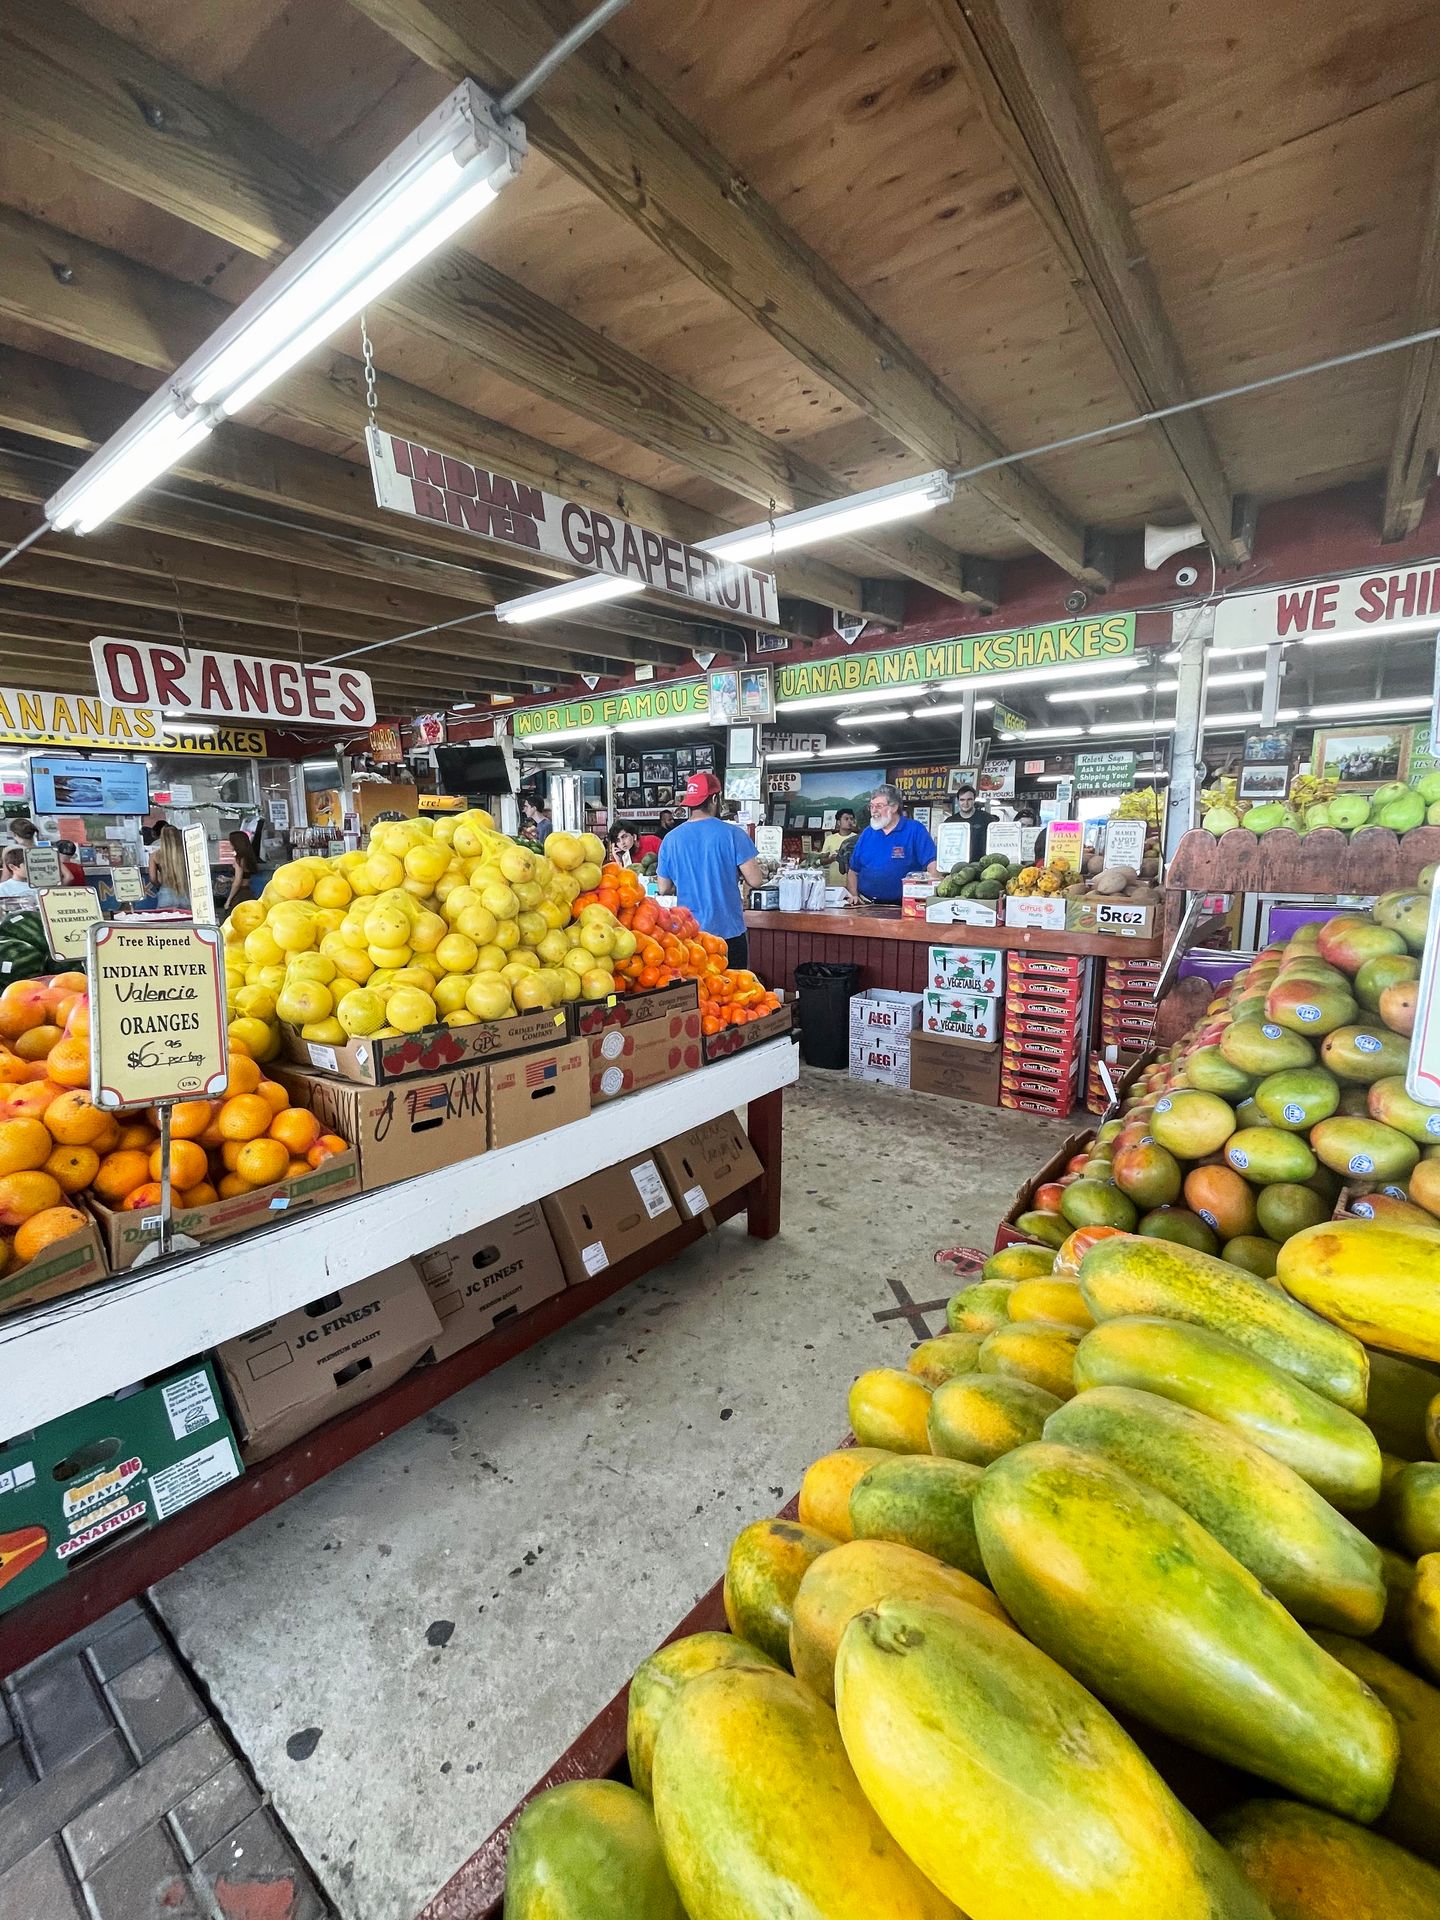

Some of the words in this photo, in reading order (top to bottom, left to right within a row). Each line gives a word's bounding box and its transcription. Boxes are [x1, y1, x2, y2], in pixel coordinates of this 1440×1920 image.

[390, 436, 546, 522] INDIAN
[410, 479, 540, 551] RIVER
[561, 501, 769, 619] GRAPEFRUIT
[1277, 585, 1340, 636] WE
[775, 651, 920, 697] UANABANA
[925, 618, 1127, 678] MILKSHAKES
[103, 642, 366, 722] ORANGES
[518, 704, 594, 734] WORLD
[603, 684, 709, 723] FAMOUS
[930, 766, 948, 774] SAYS
[1080, 773, 1110, 781] Shipping
[916, 777, 934, 789] OUT
[1019, 903, 1042, 912] Citrus
[50, 915, 100, 923] WATERMELONS
[117, 936, 144, 947] Tree
[147, 936, 190, 950] Ripened
[103, 965, 159, 979] INDIAN
[164, 963, 208, 977] RIVER
[115, 983, 198, 1003] Valencia
[947, 977, 981, 990] VEGETABLES
[120, 1012, 199, 1036] ORANGES
[868, 1011, 892, 1026] AEG
[940, 1020, 974, 1034] VEGETABLES
[522, 1029, 553, 1041] COMPANY
[867, 1052, 891, 1067] AEG
[181, 1080, 198, 1088] USA
[465, 1280, 482, 1298] JC
[484, 1258, 525, 1290] FINEST
[296, 1326, 320, 1350] JC
[322, 1299, 383, 1337] FINEST
[316, 1344, 353, 1366] PREMIUM
[351, 1329, 381, 1350] QUALITY
[69, 1482, 122, 1513] PAPAYA
[58, 1501, 146, 1557] PANAFRUIT
